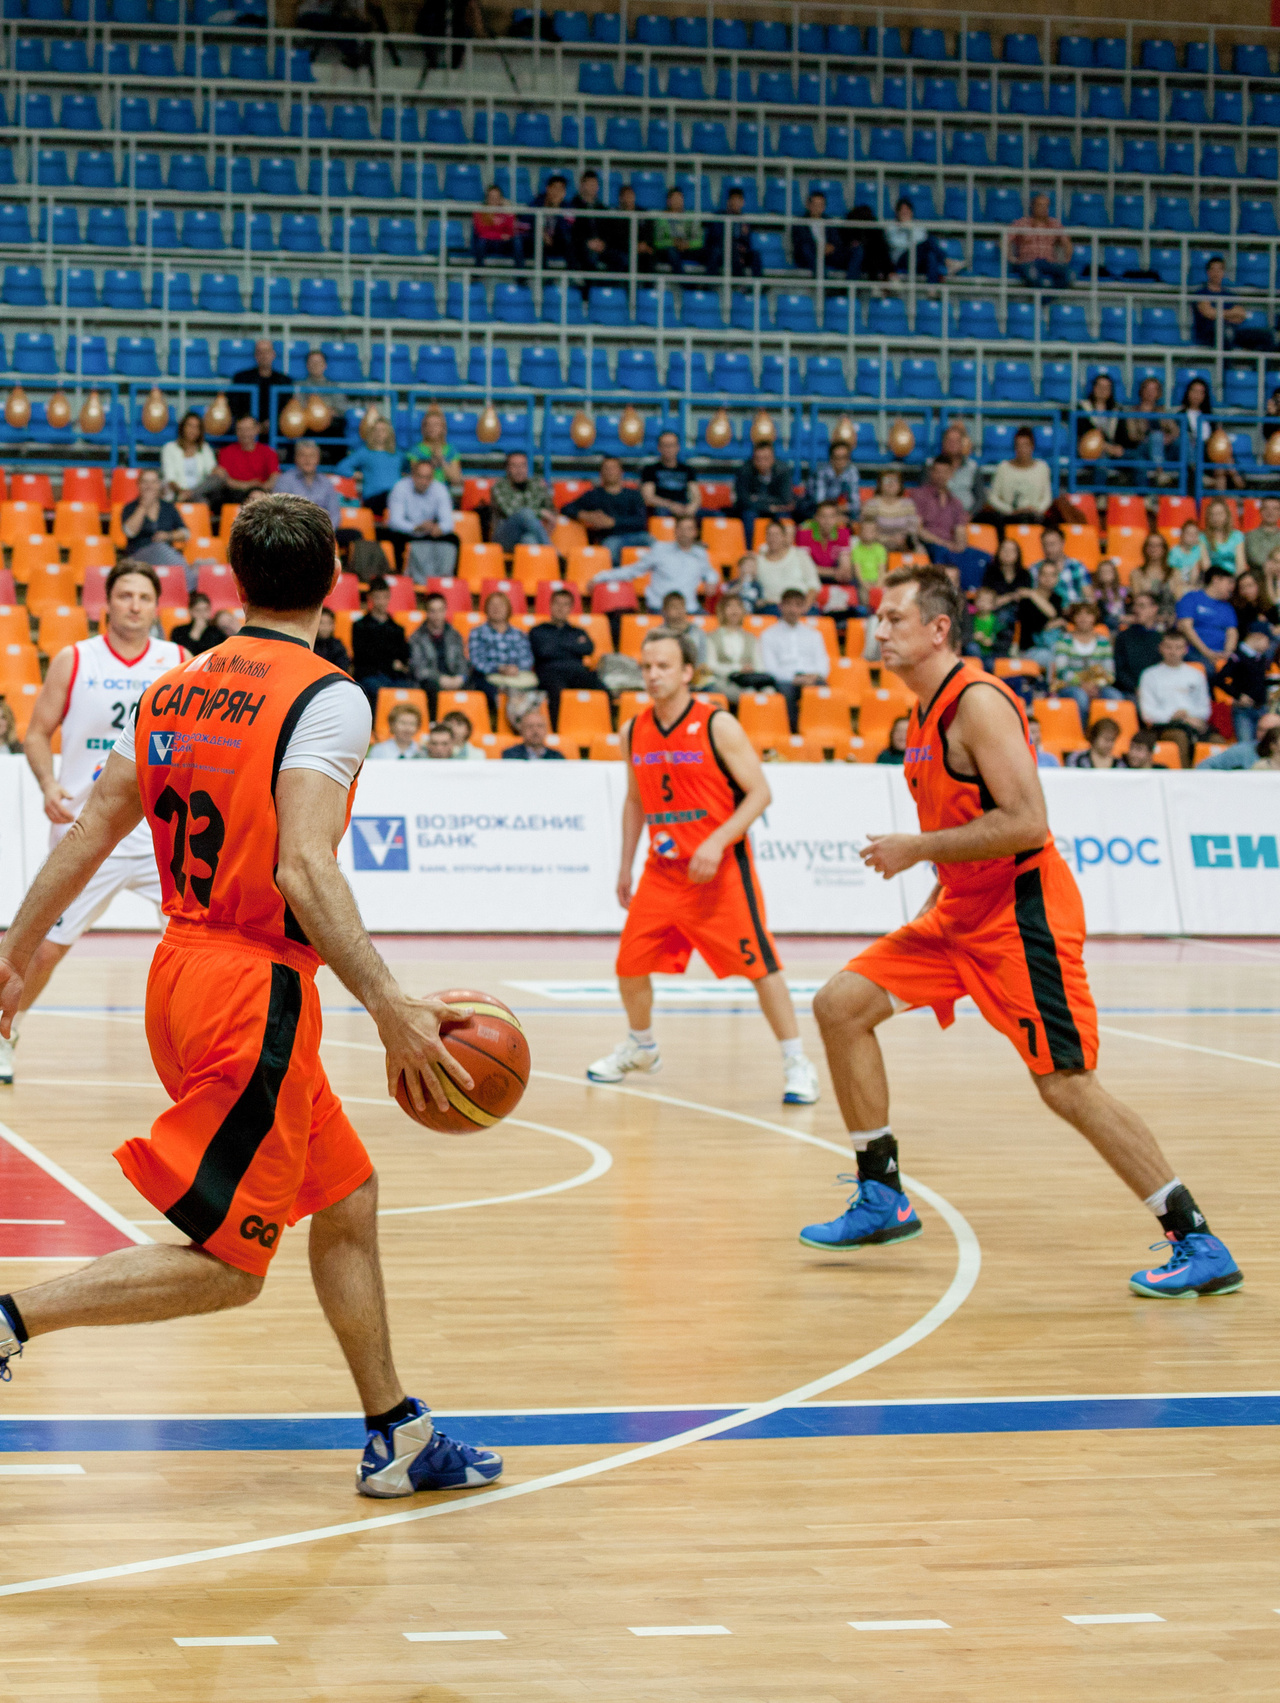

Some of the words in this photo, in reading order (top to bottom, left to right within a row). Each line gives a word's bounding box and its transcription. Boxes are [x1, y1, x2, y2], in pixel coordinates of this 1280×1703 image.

[227, 654, 271, 679] Москвы
[103, 678, 152, 691] астер
[151, 684, 266, 726] САГИРЯН
[661, 773, 673, 802] 5
[416, 814, 586, 831] ВОЗРОЖДЕНИЕ
[417, 833, 477, 848] БАНК
[738, 937, 757, 966] 5
[239, 1214, 280, 1250] GQ
